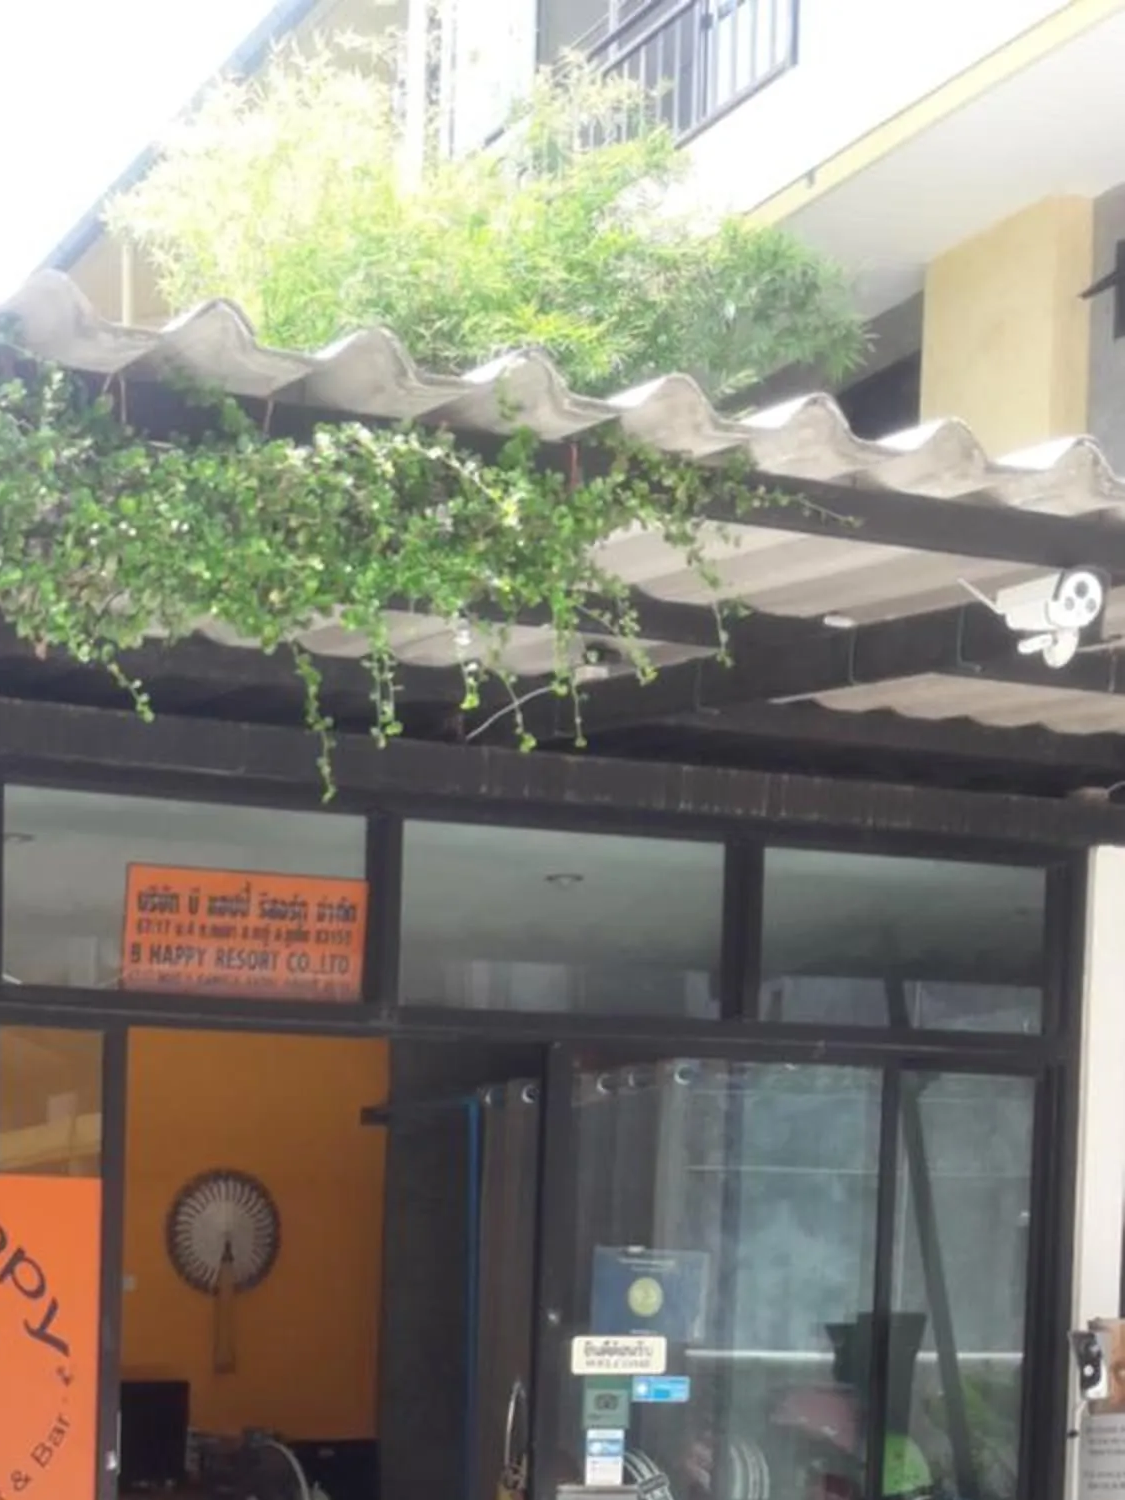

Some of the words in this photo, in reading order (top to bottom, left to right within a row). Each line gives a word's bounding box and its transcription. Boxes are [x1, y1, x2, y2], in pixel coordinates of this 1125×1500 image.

[130, 942, 141, 964] B
[149, 944, 207, 968] HAPPY
[215, 947, 280, 973] RESORT
[10, 1469, 32, 1492] &
[30, 1412, 71, 1469] Bar
